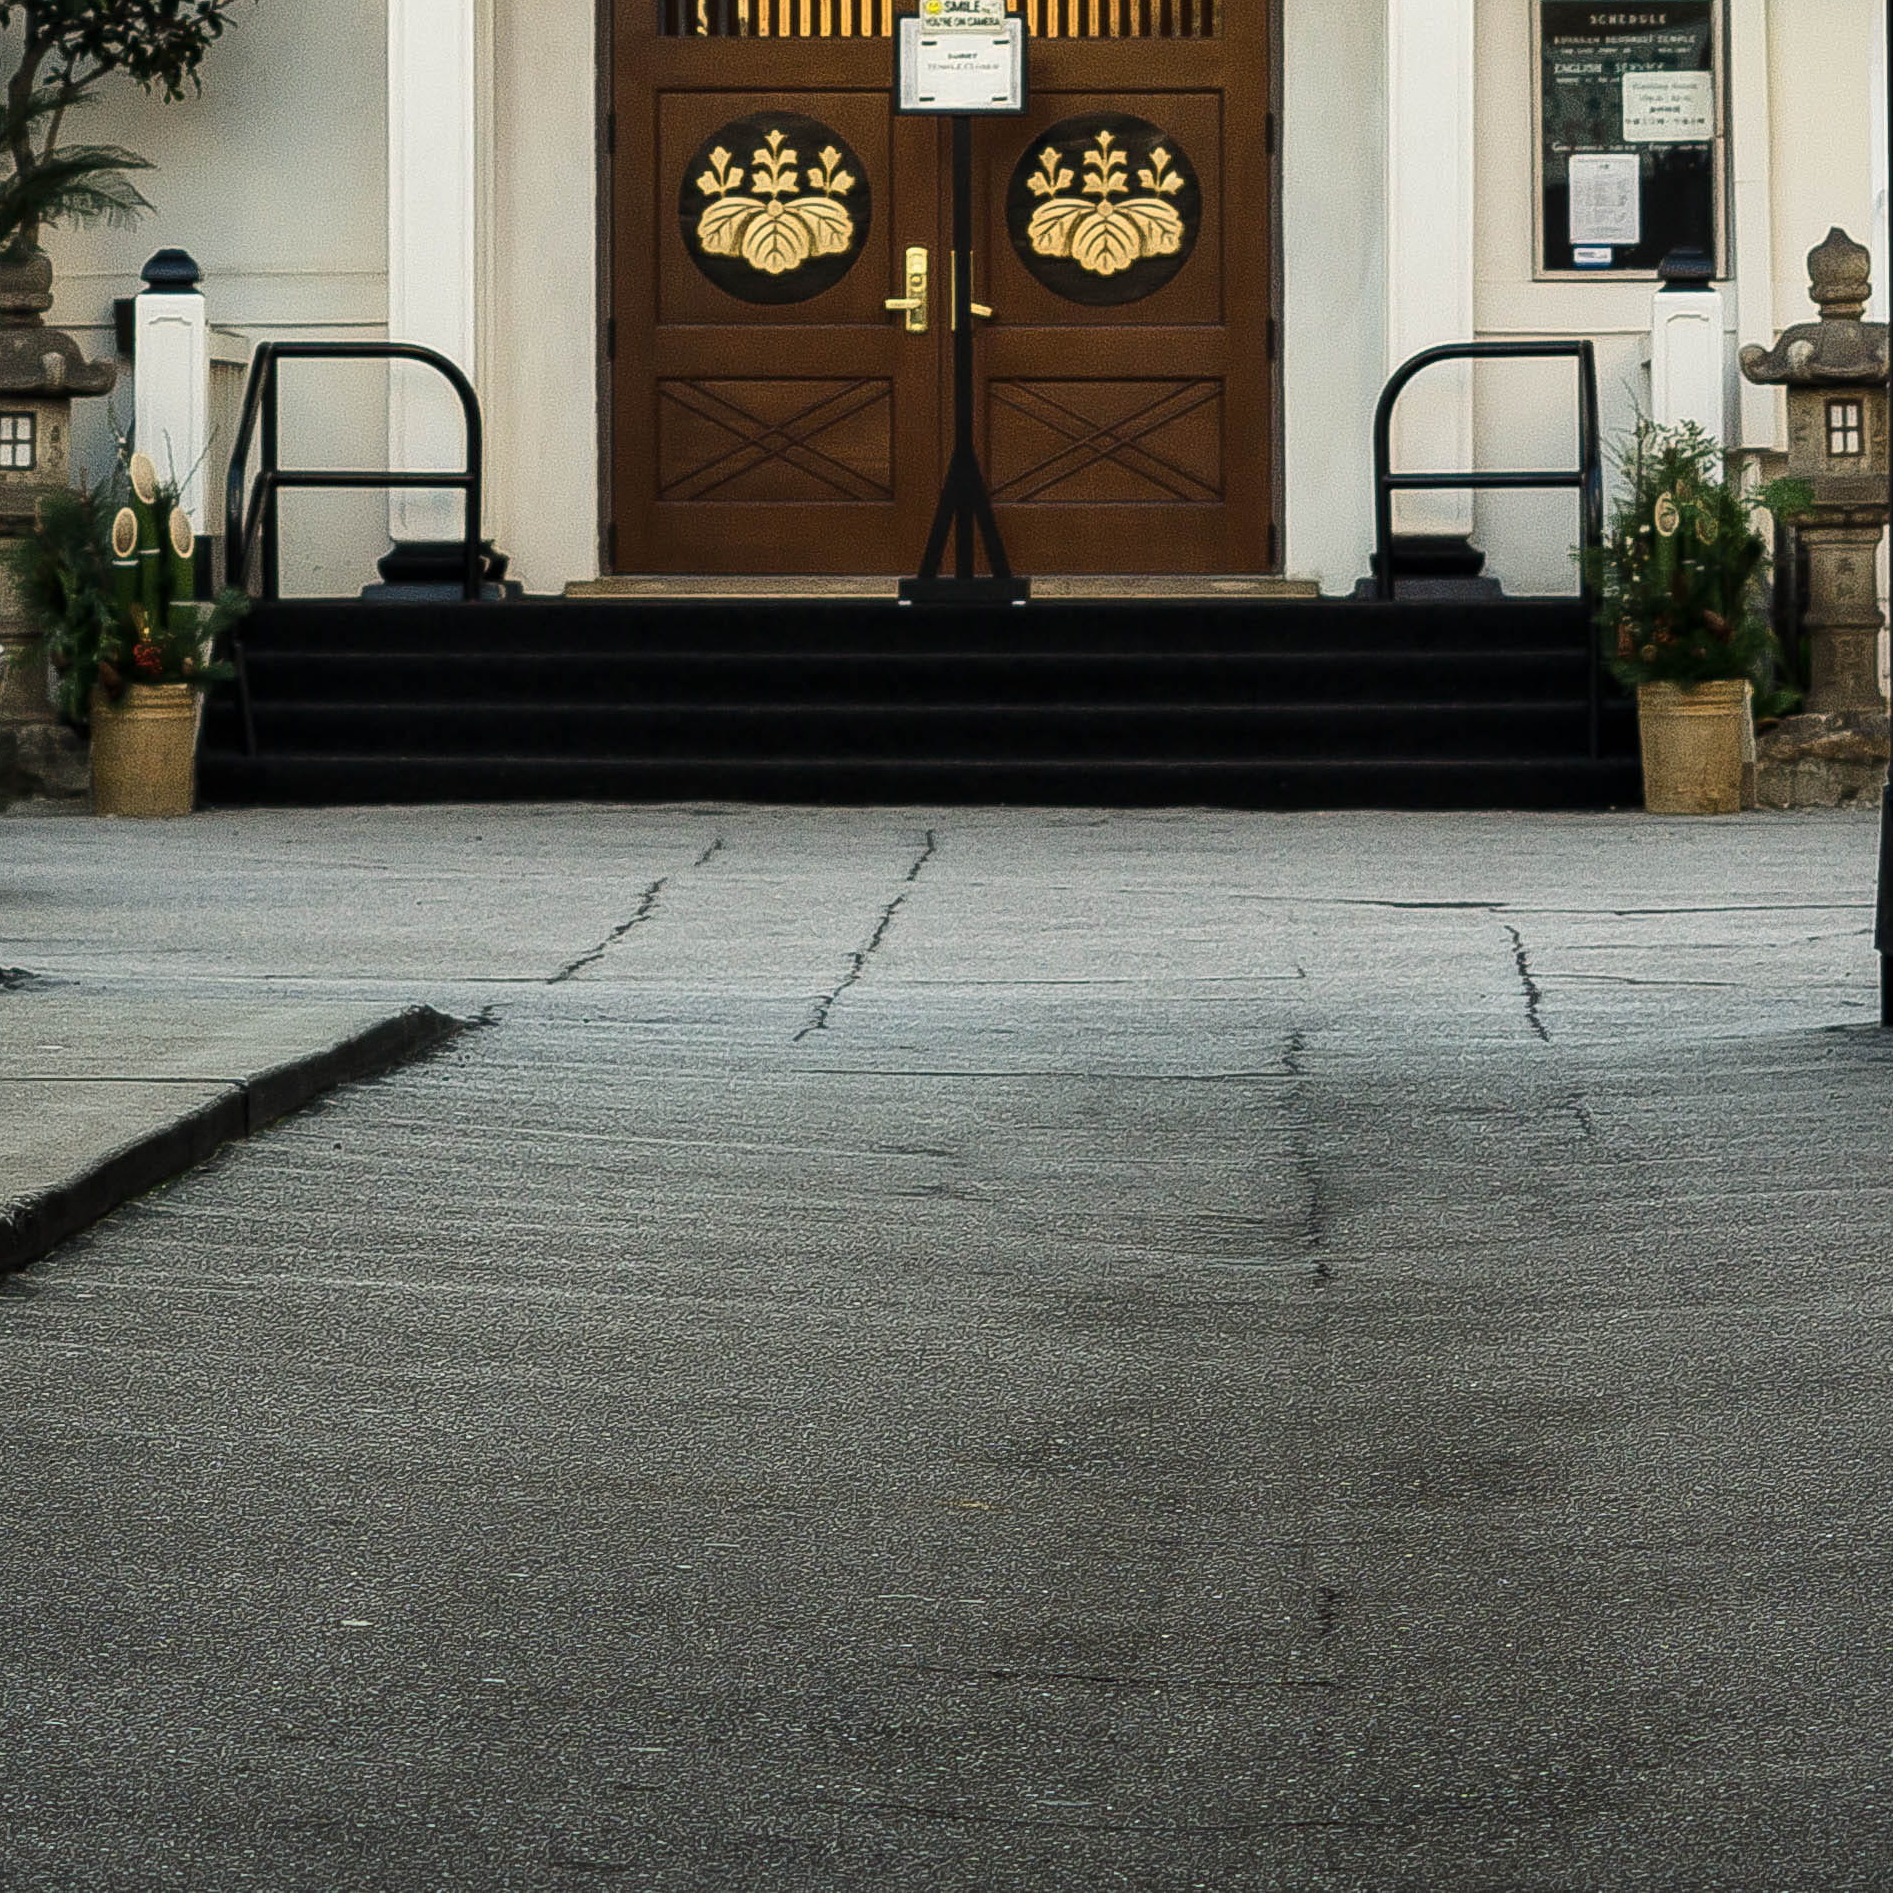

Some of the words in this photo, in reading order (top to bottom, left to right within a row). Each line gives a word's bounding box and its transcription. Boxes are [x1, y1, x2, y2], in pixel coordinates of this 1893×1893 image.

[944, 0, 980, 13] SMILE
[954, 17, 966, 27] ON
[967, 17, 1000, 27] CAMERA
[1589, 13, 1667, 25] SCHEDULE
